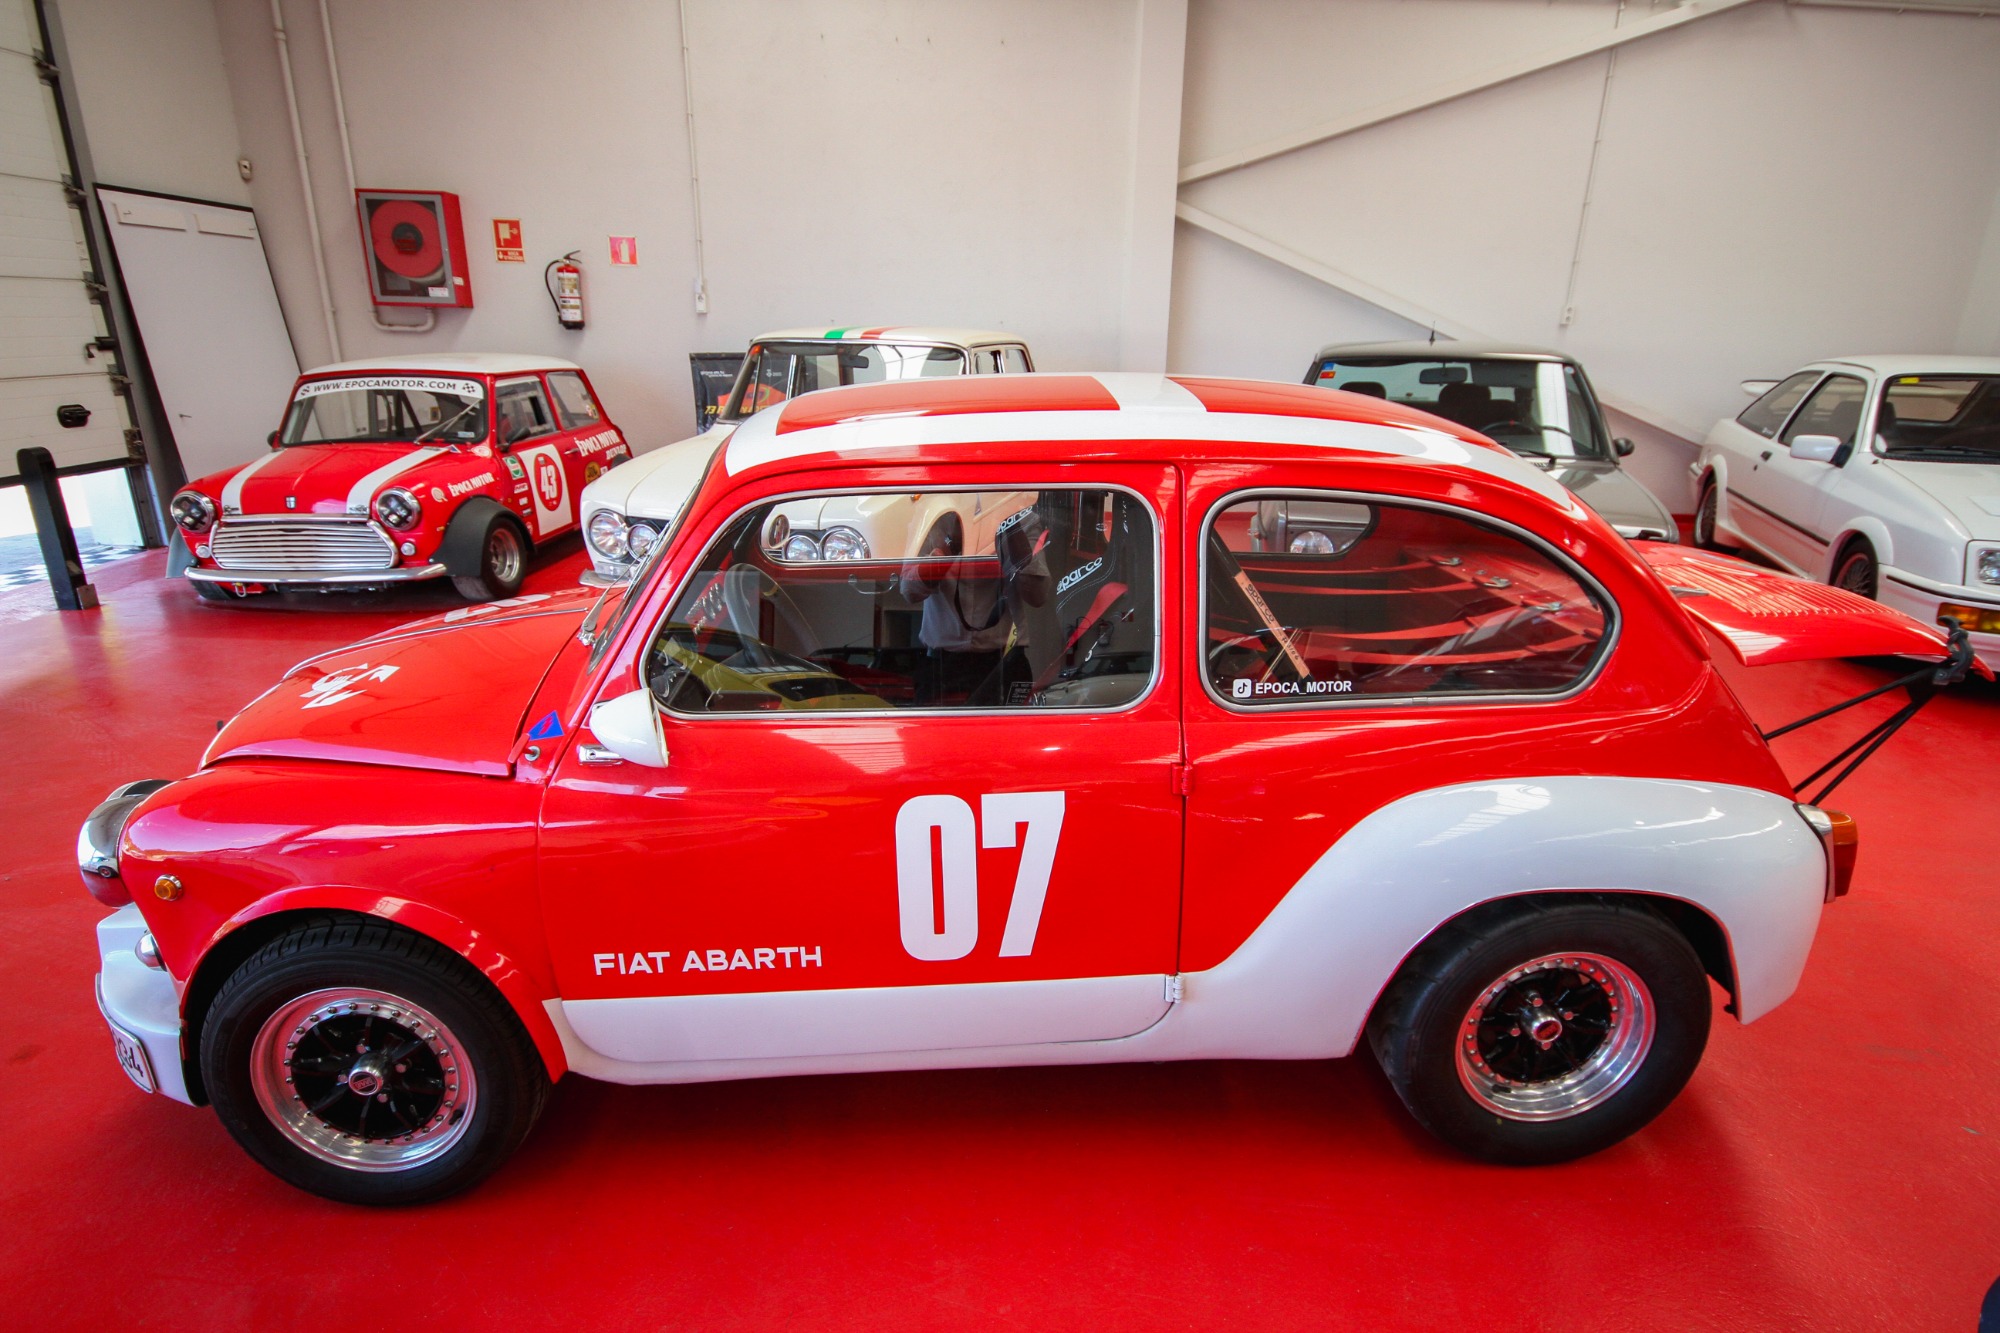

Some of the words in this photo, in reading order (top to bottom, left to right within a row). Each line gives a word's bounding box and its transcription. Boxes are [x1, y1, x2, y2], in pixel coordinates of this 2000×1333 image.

[313, 379, 457, 393] WWW.EPOCAMOTOR.COM
[540, 464, 558, 500] 43
[996, 505, 1033, 536] sparco
[1056, 556, 1103, 595] sparco
[1254, 680, 1353, 695] EPOCA_MOTOR
[895, 790, 1066, 962] 07
[593, 951, 671, 976] FIAT
[681, 945, 823, 973] ABARTH
